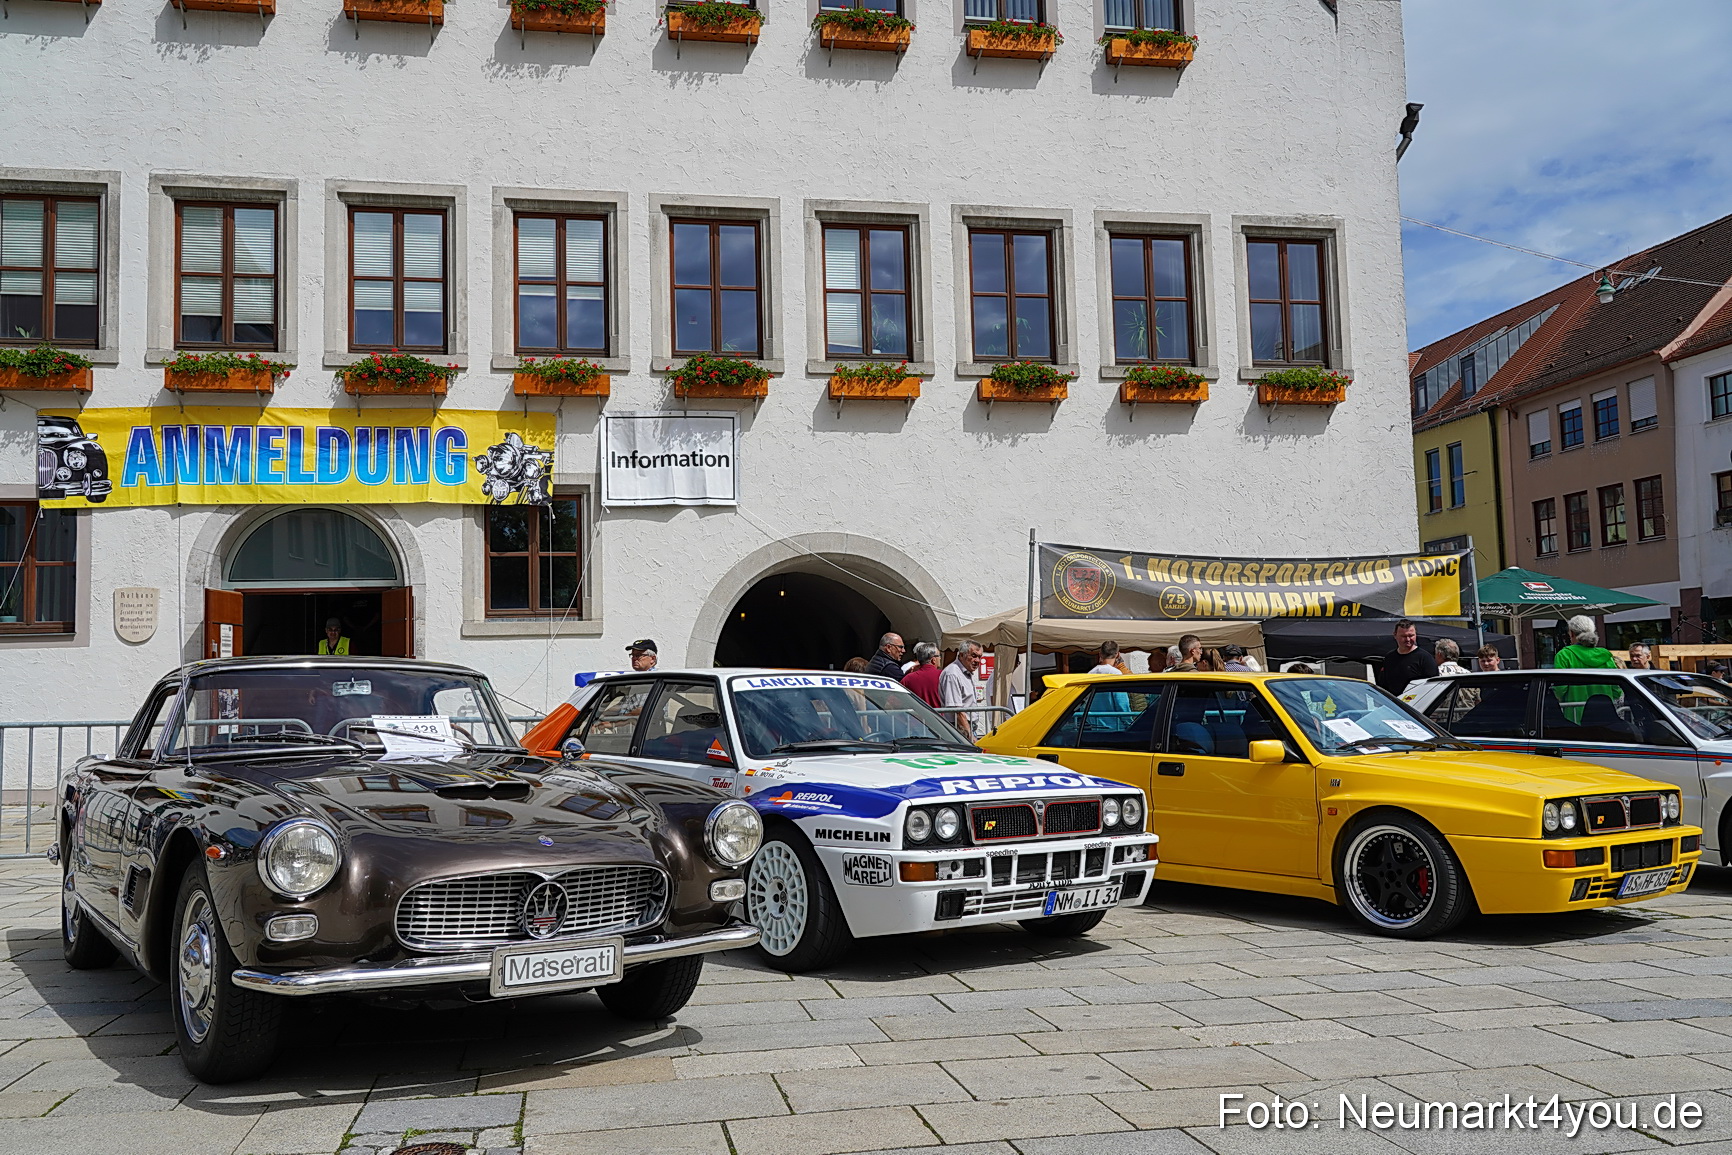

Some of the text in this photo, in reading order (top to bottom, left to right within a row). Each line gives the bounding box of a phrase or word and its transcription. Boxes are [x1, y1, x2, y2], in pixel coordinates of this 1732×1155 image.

[121, 424, 469, 487] ANMELDUNG
[610, 448, 730, 470] Information
[1119, 555, 1395, 587] 1. MOTORSPORTCLUB
[1407, 557, 1458, 577] ADAC
[1166, 593, 1186, 604] 75
[1194, 590, 1362, 617] NEUMARKT e.V.
[747, 677, 895, 689] LANCIA REPSOL
[712, 777, 733, 789] Tudor
[940, 775, 1103, 795] REPSOL
[794, 792, 834, 802] REPSOL
[815, 828, 891, 842] MICHELIN
[985, 849, 1018, 858] speedline
[1084, 841, 1112, 849] speedline
[844, 855, 892, 872] MAGNETI
[844, 867, 892, 884] MARELLI
[1625, 876, 1641, 892] AS
[1642, 873, 1658, 889] HF
[1053, 892, 1075, 911] NM
[1082, 889, 1100, 907] II
[1102, 887, 1120, 904] 31
[509, 949, 610, 981] Maserati
